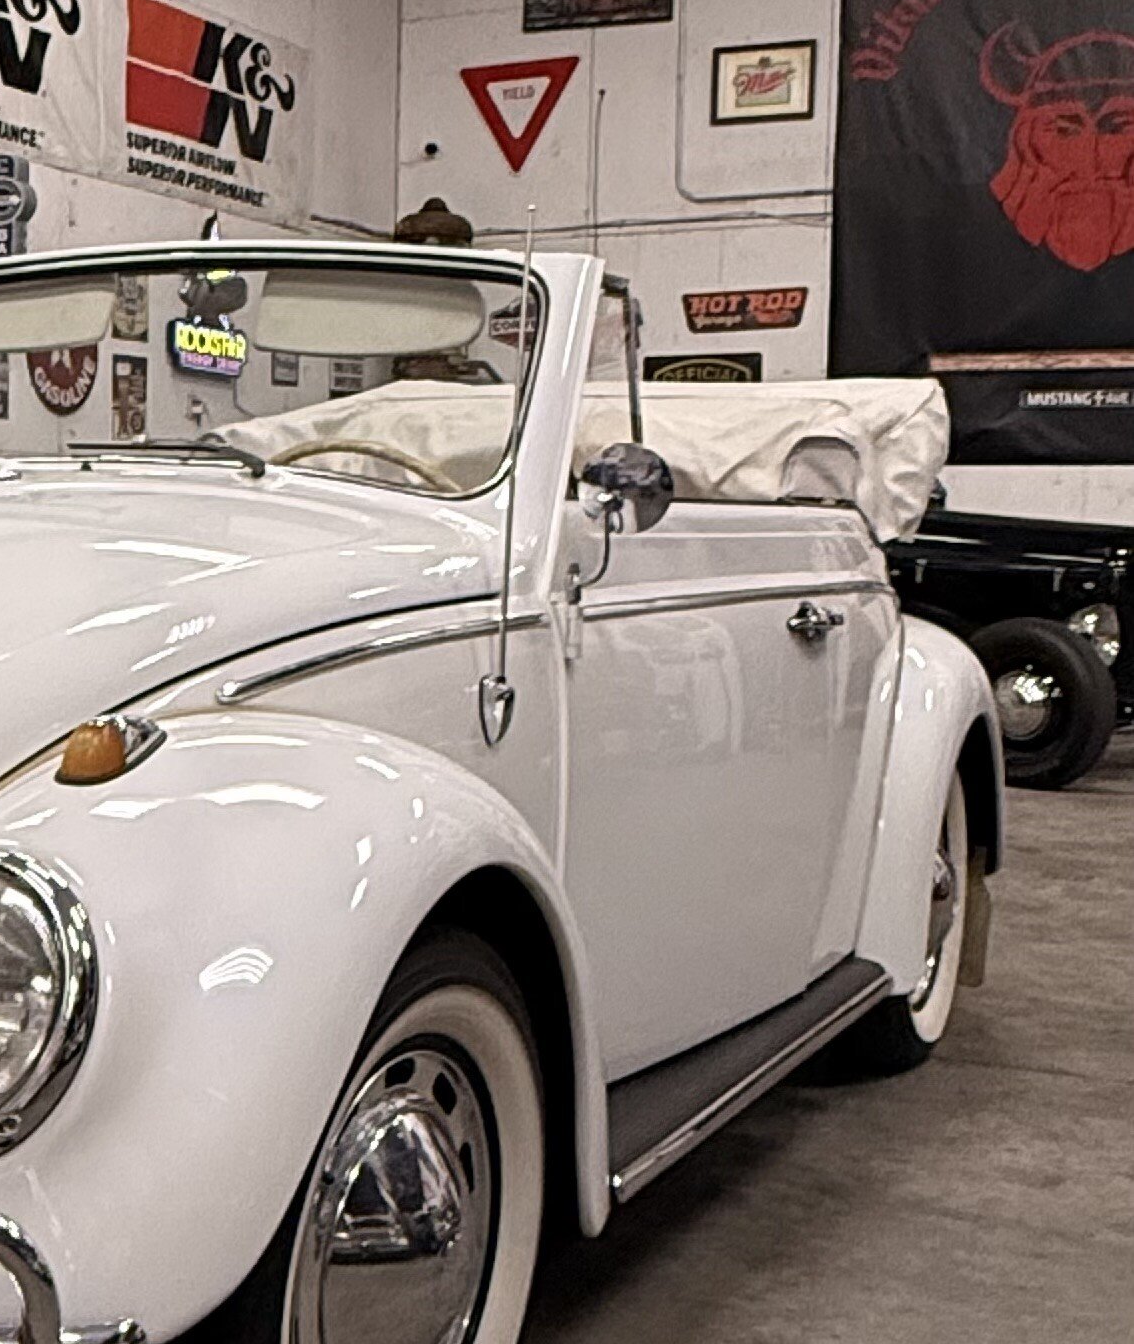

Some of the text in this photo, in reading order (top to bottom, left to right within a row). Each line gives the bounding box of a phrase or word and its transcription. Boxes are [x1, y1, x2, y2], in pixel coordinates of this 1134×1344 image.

[501, 84, 536, 101] YIELD
[688, 290, 803, 315] HOT ROD
[1026, 391, 1093, 407] MUSTANG
